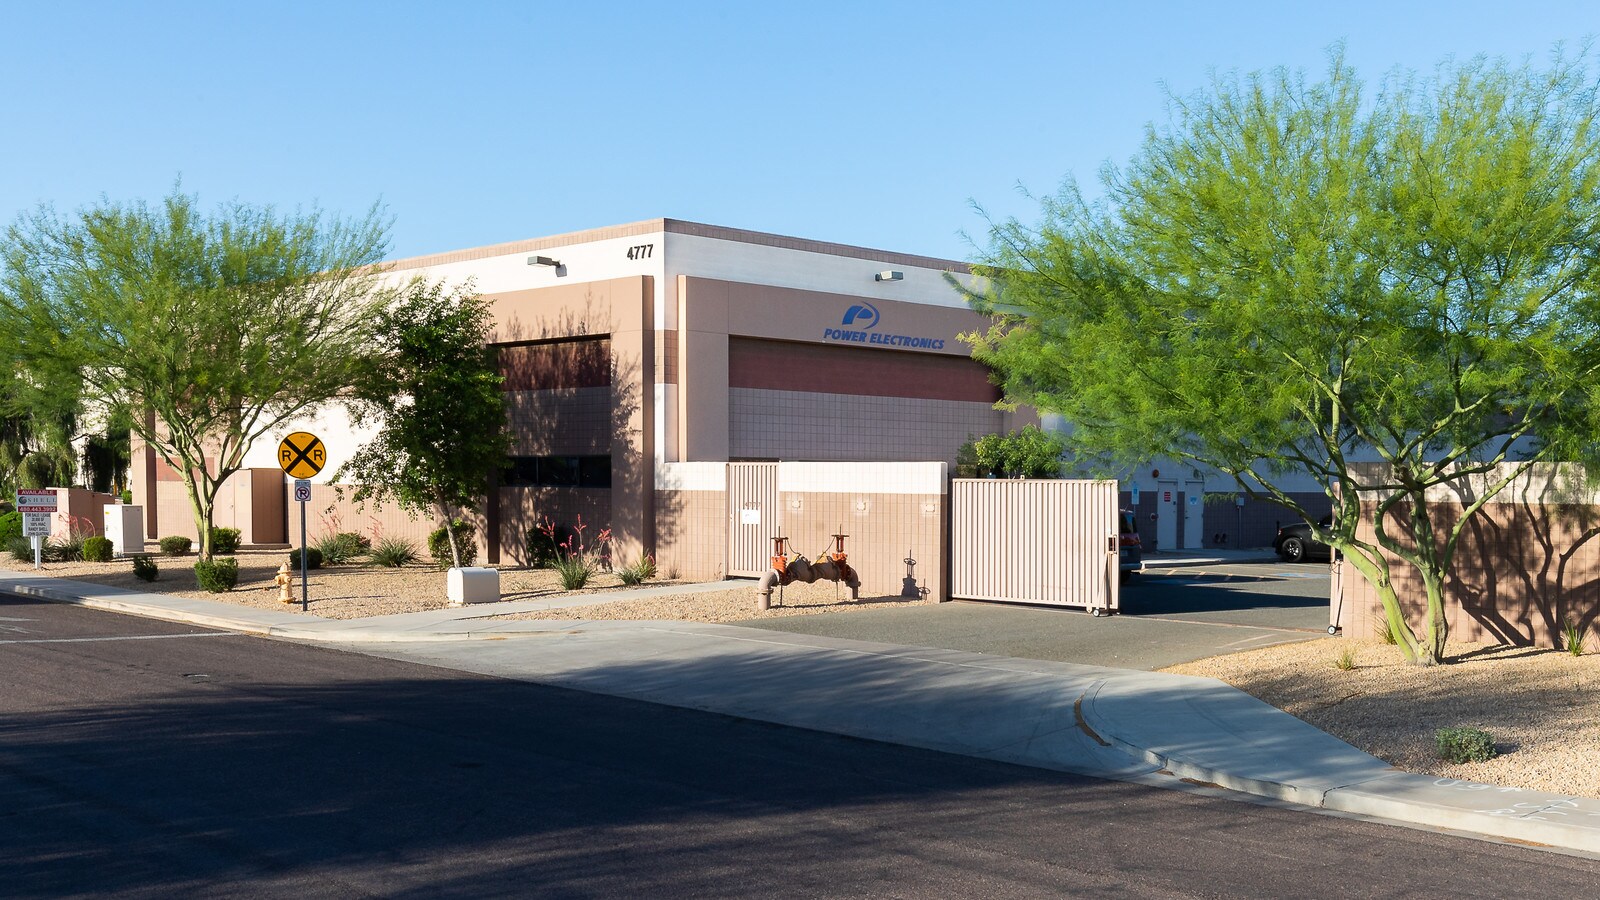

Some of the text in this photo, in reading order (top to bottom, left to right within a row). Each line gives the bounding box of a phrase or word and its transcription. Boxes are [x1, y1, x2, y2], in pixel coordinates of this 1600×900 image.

[627, 244, 654, 260] 4777
[823, 328, 945, 350] POWER ELECTRONICS
[282, 449, 323, 461] R R
